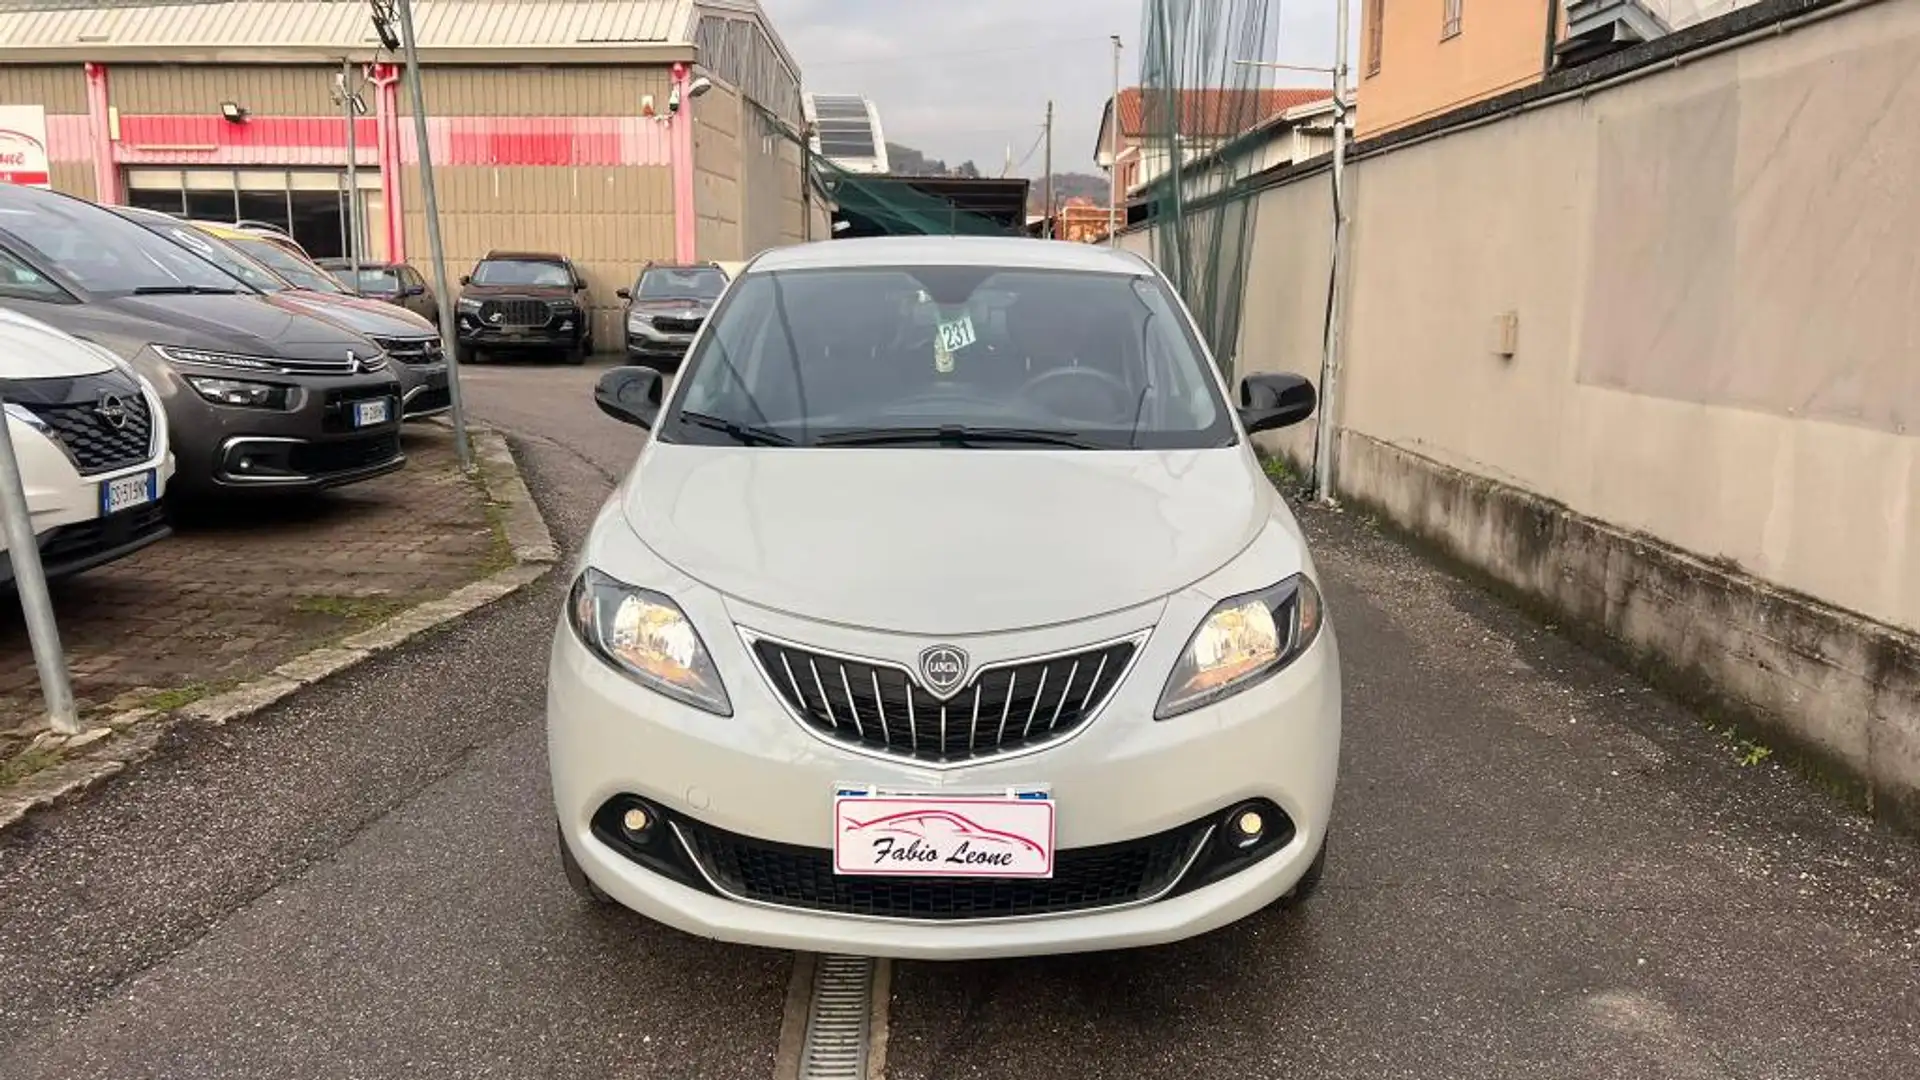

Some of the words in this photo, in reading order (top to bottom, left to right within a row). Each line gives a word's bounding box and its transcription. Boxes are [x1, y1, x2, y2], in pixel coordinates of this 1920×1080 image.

[943, 319, 970, 349] 231
[930, 662, 957, 672] LANCIA
[872, 837, 938, 864] Fabio
[945, 841, 1013, 866] Leone
